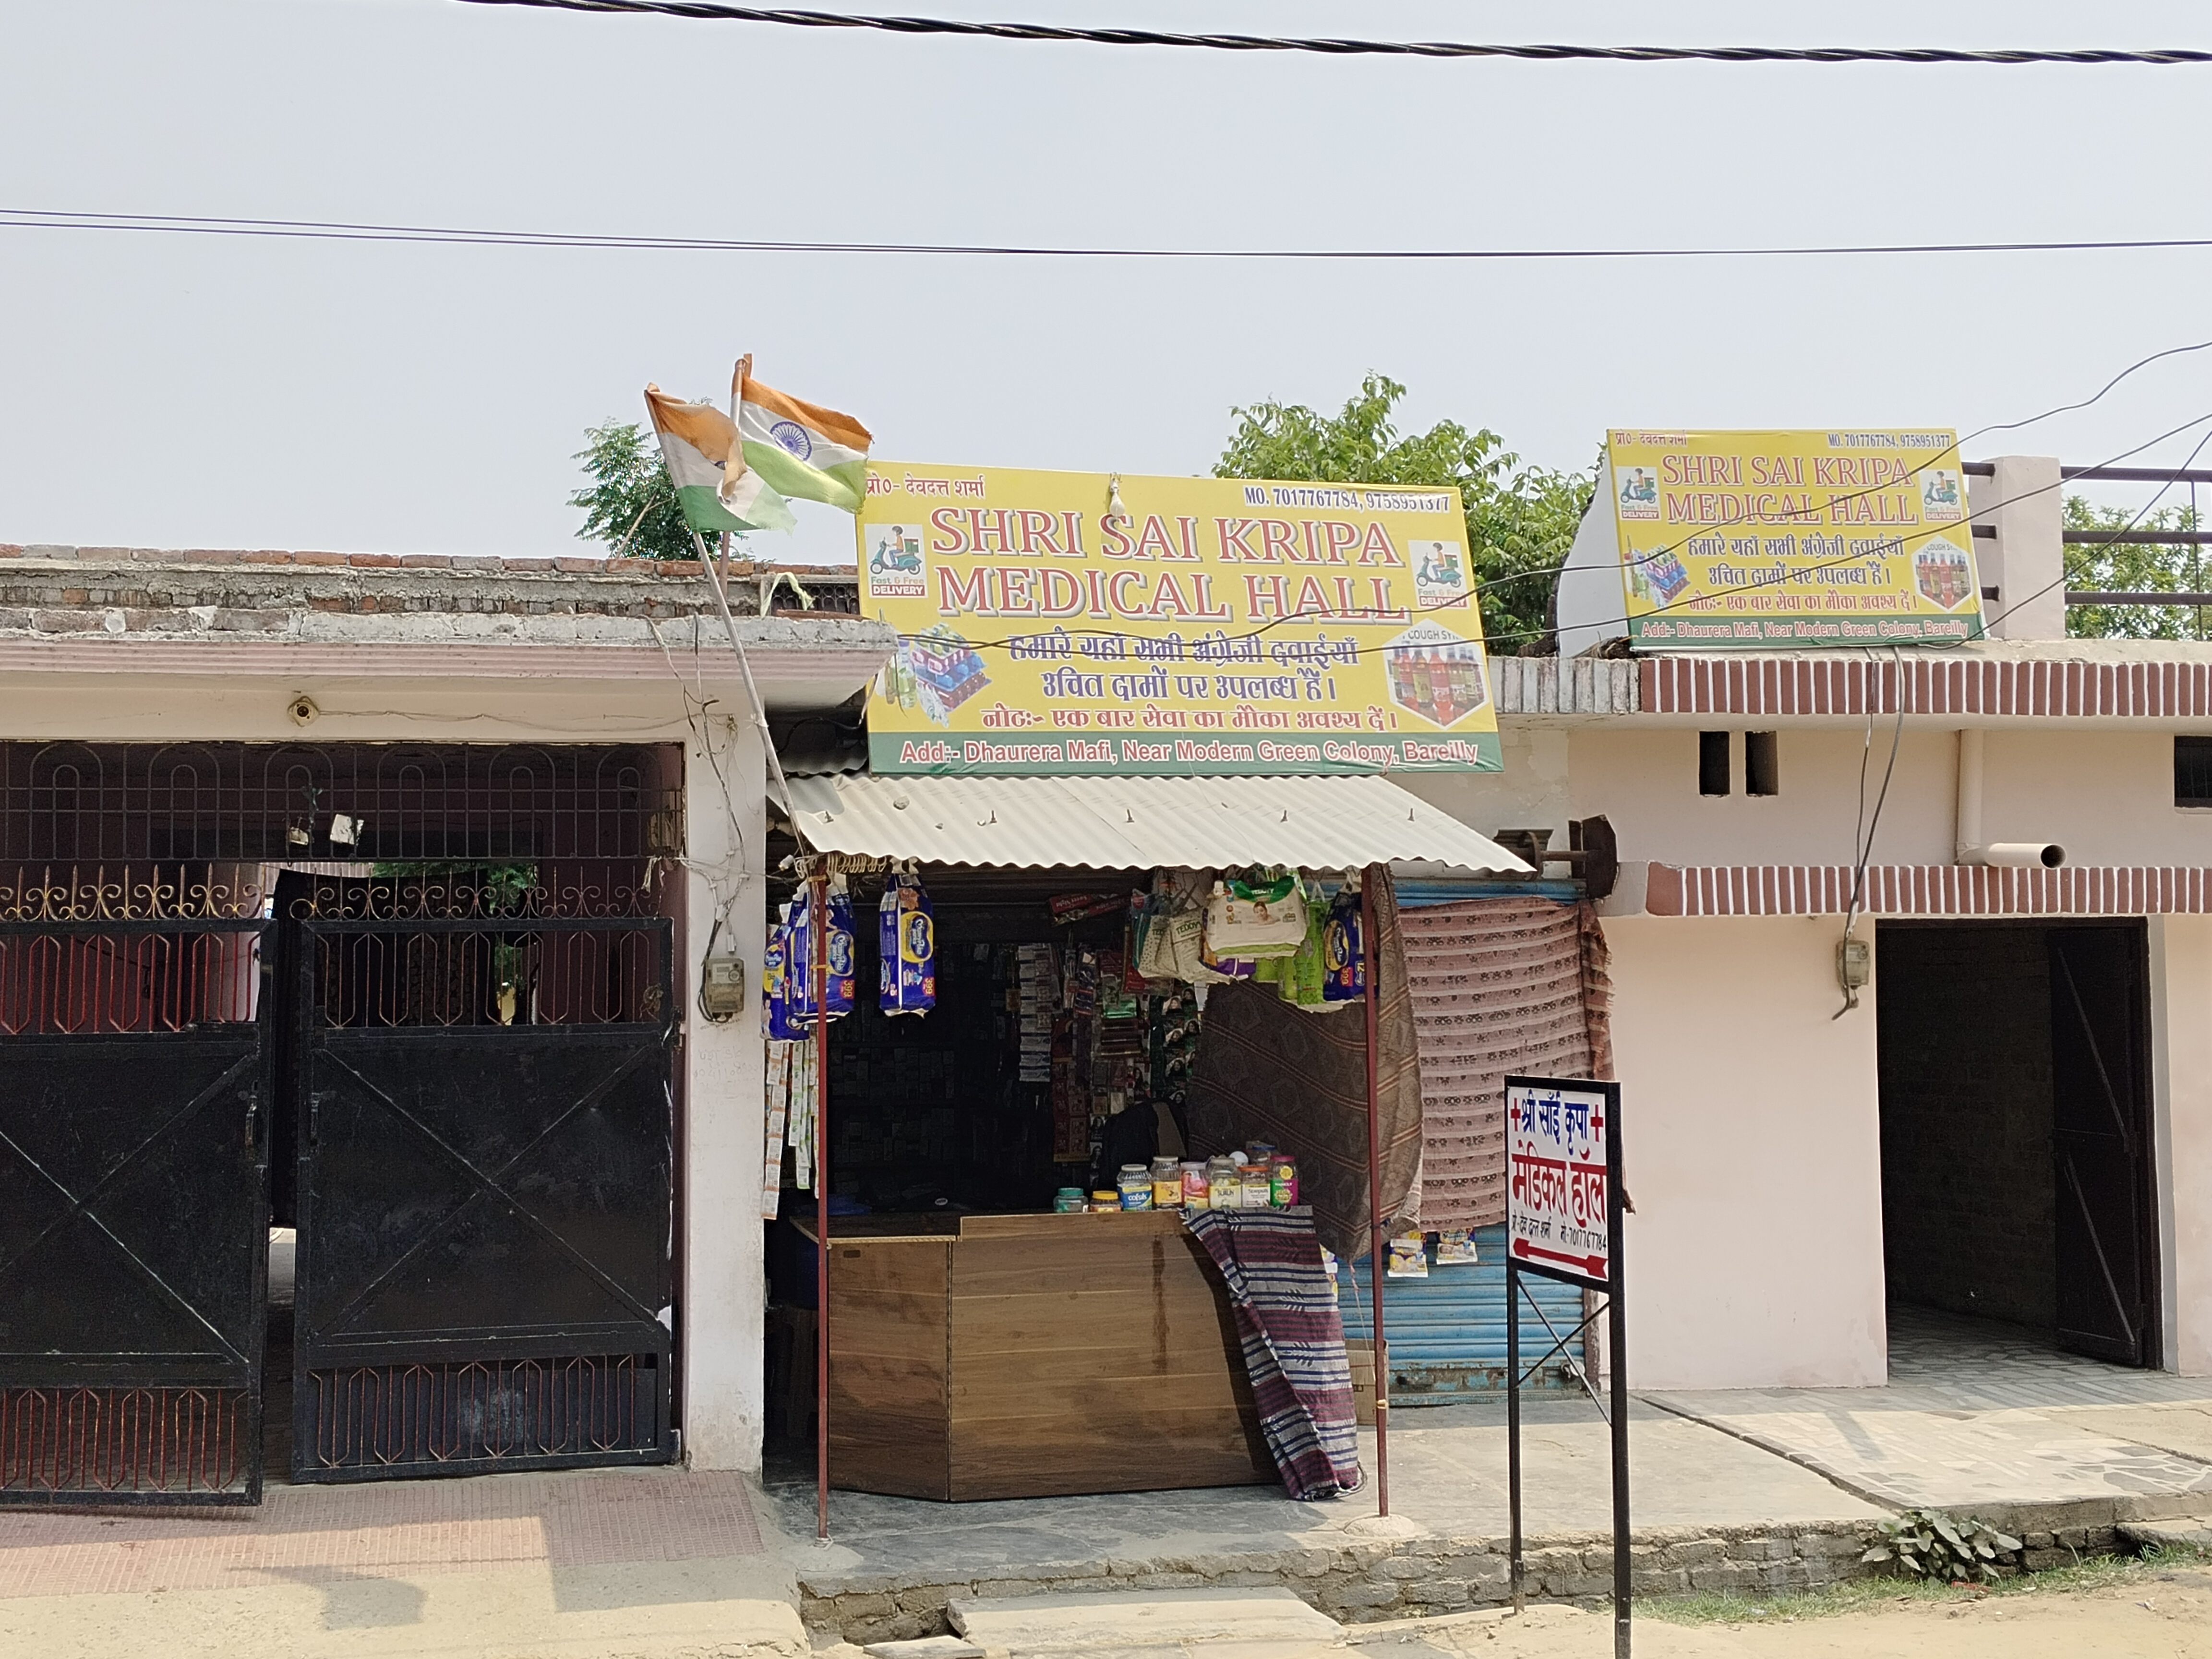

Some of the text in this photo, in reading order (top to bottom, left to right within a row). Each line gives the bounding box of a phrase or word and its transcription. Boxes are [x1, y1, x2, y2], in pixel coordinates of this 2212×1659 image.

[1639, 430, 1666, 445] देवदत्त
[1828, 433, 1950, 449] MO. 7017767784, 9758951377
[1662, 455, 1915, 487] SHRI SAI KRIPA
[905, 472, 950, 496] देवदत्त
[955, 474, 985, 497] शर्मा
[1244, 486, 1450, 513] MO. 7017767784, 9758951377
[1665, 493, 1919, 526] MEDICAL HALL
[931, 507, 1406, 567] SHRI SAI KRIPA
[1687, 532, 1905, 560] हमारे यहाँ सभी अंग्रेजी दवाईयाँ
[871, 576, 892, 584] Fast
[903, 577, 925, 585] Free
[1708, 564, 1747, 585] उचित
[1750, 561, 1787, 587] दामों
[1791, 567, 1812, 584] पर
[1816, 567, 1867, 585] उपलब्ध
[873, 585, 924, 595] DELIVERY
[934, 566, 1412, 625] MEDICAL HALL
[1725, 595, 1747, 611] एक
[1750, 595, 1772, 611] बार
[1776, 589, 1801, 611] सेवा
[1804, 595, 1822, 610] का
[1825, 589, 1858, 610] मौका
[1861, 595, 1898, 611] अवश्य
[1407, 630, 1440, 640] COUGH
[1642, 620, 1968, 639] Add:- Dhaurera Mafi, Near Modern Green Colony, Bareilly
[1007, 625, 1072, 661] हमारे
[1131, 632, 1186, 662] सभी
[1191, 629, 1265, 667] अंग्रेजी
[1041, 666, 1105, 698] उचित
[1109, 665, 1170, 701] दामों
[1175, 674, 1209, 699] पर
[1215, 674, 1298, 700] उपलब्ध
[1050, 709, 1091, 728] एक
[1095, 709, 1136, 727] बार
[1138, 703, 1186, 728] सेवा
[1193, 710, 1226, 728] का
[1232, 704, 1291, 729] मौका
[1297, 710, 1362, 730] अवश्य
[900, 740, 1479, 766] Add:- Dhaurera Mafi, Near Modern Green Colony, Bareilly
[843, 980, 853, 998] 399
[925, 977, 933, 994] 399
[1522, 1088, 1536, 1134] श्री
[1564, 1102, 1589, 1156] कृपा
[1511, 1139, 1607, 1228] मेडिकल हॉल
